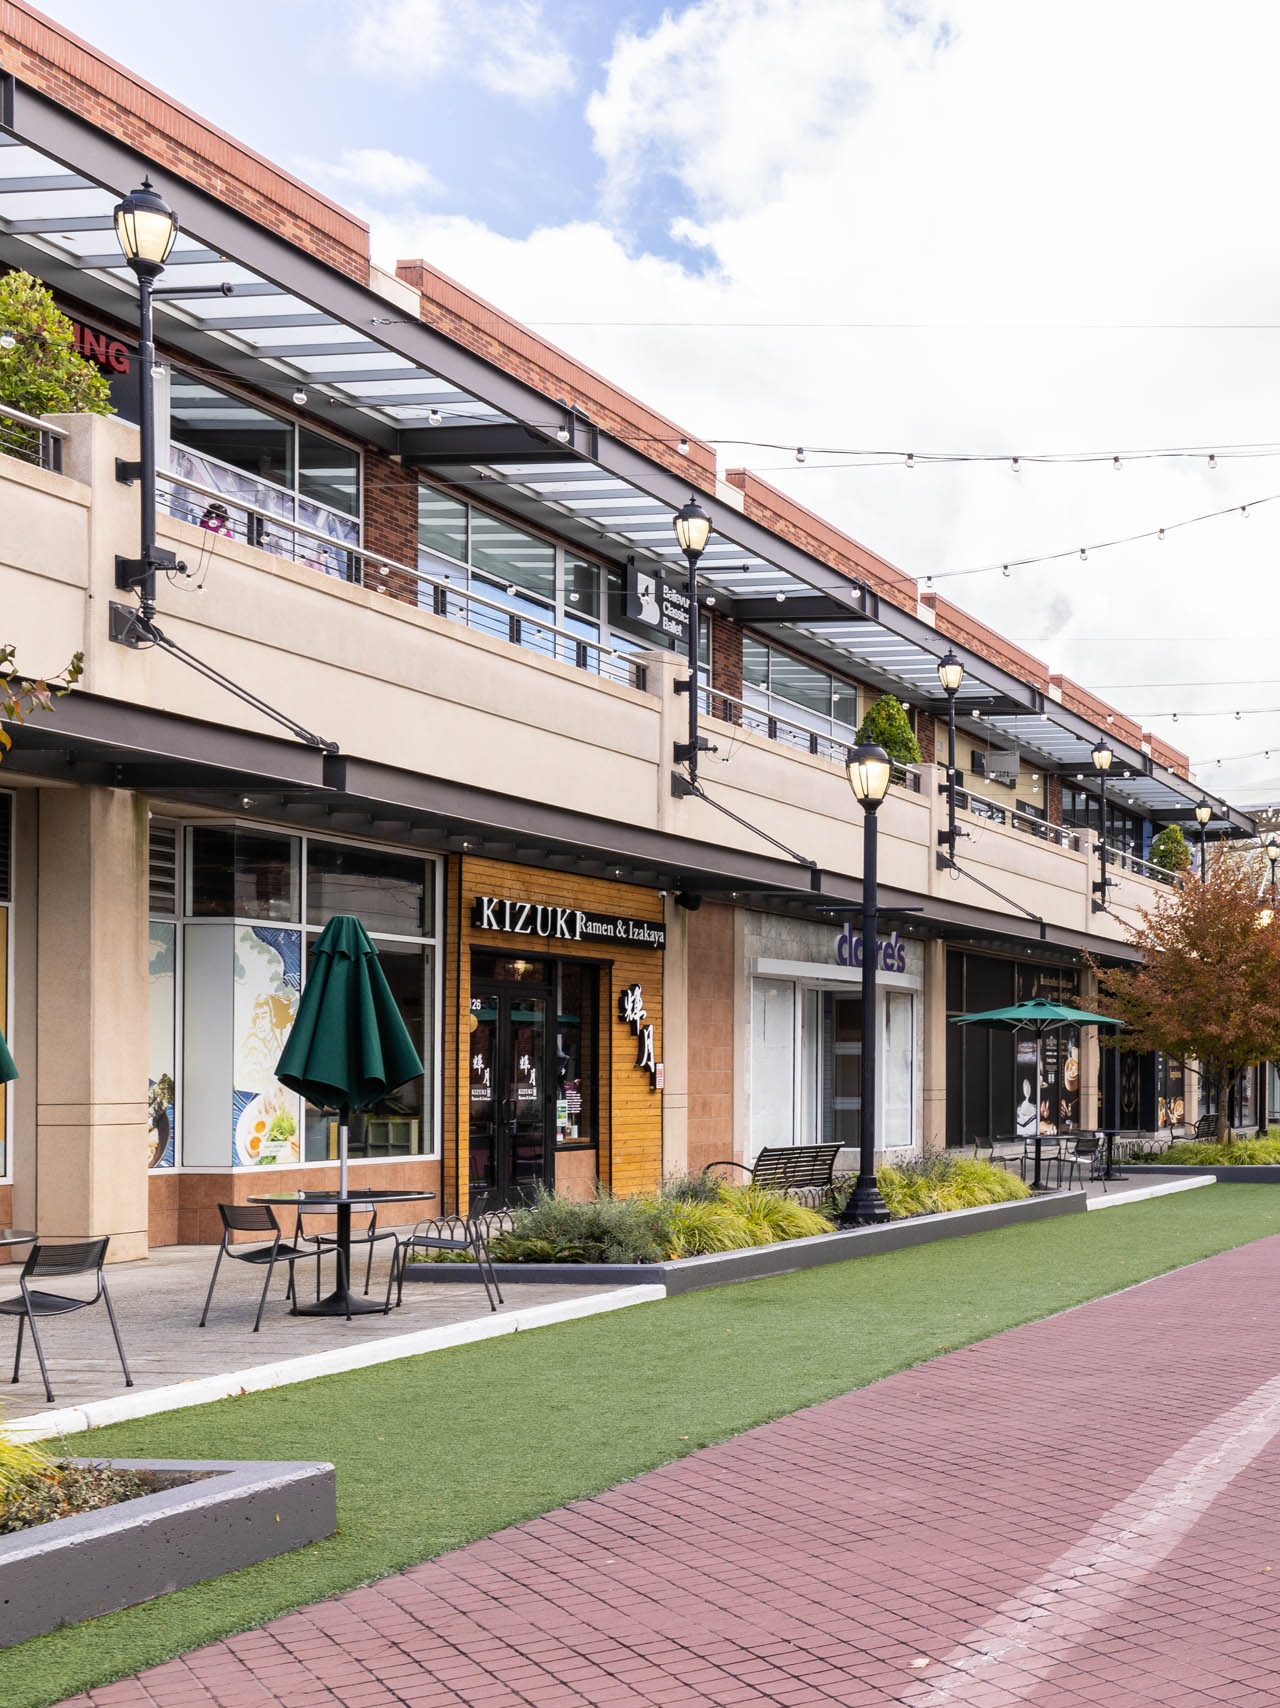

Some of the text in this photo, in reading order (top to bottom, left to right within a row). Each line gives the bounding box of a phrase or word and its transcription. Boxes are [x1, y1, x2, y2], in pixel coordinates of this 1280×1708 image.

[73, 322, 130, 374] ING
[663, 585, 690, 609] Bellevu
[663, 601, 690, 625] Classic
[662, 616, 683, 637] Ballet
[481, 896, 665, 947] KIZUKI Ramen & Izakaya
[836, 922, 906, 973] clare's
